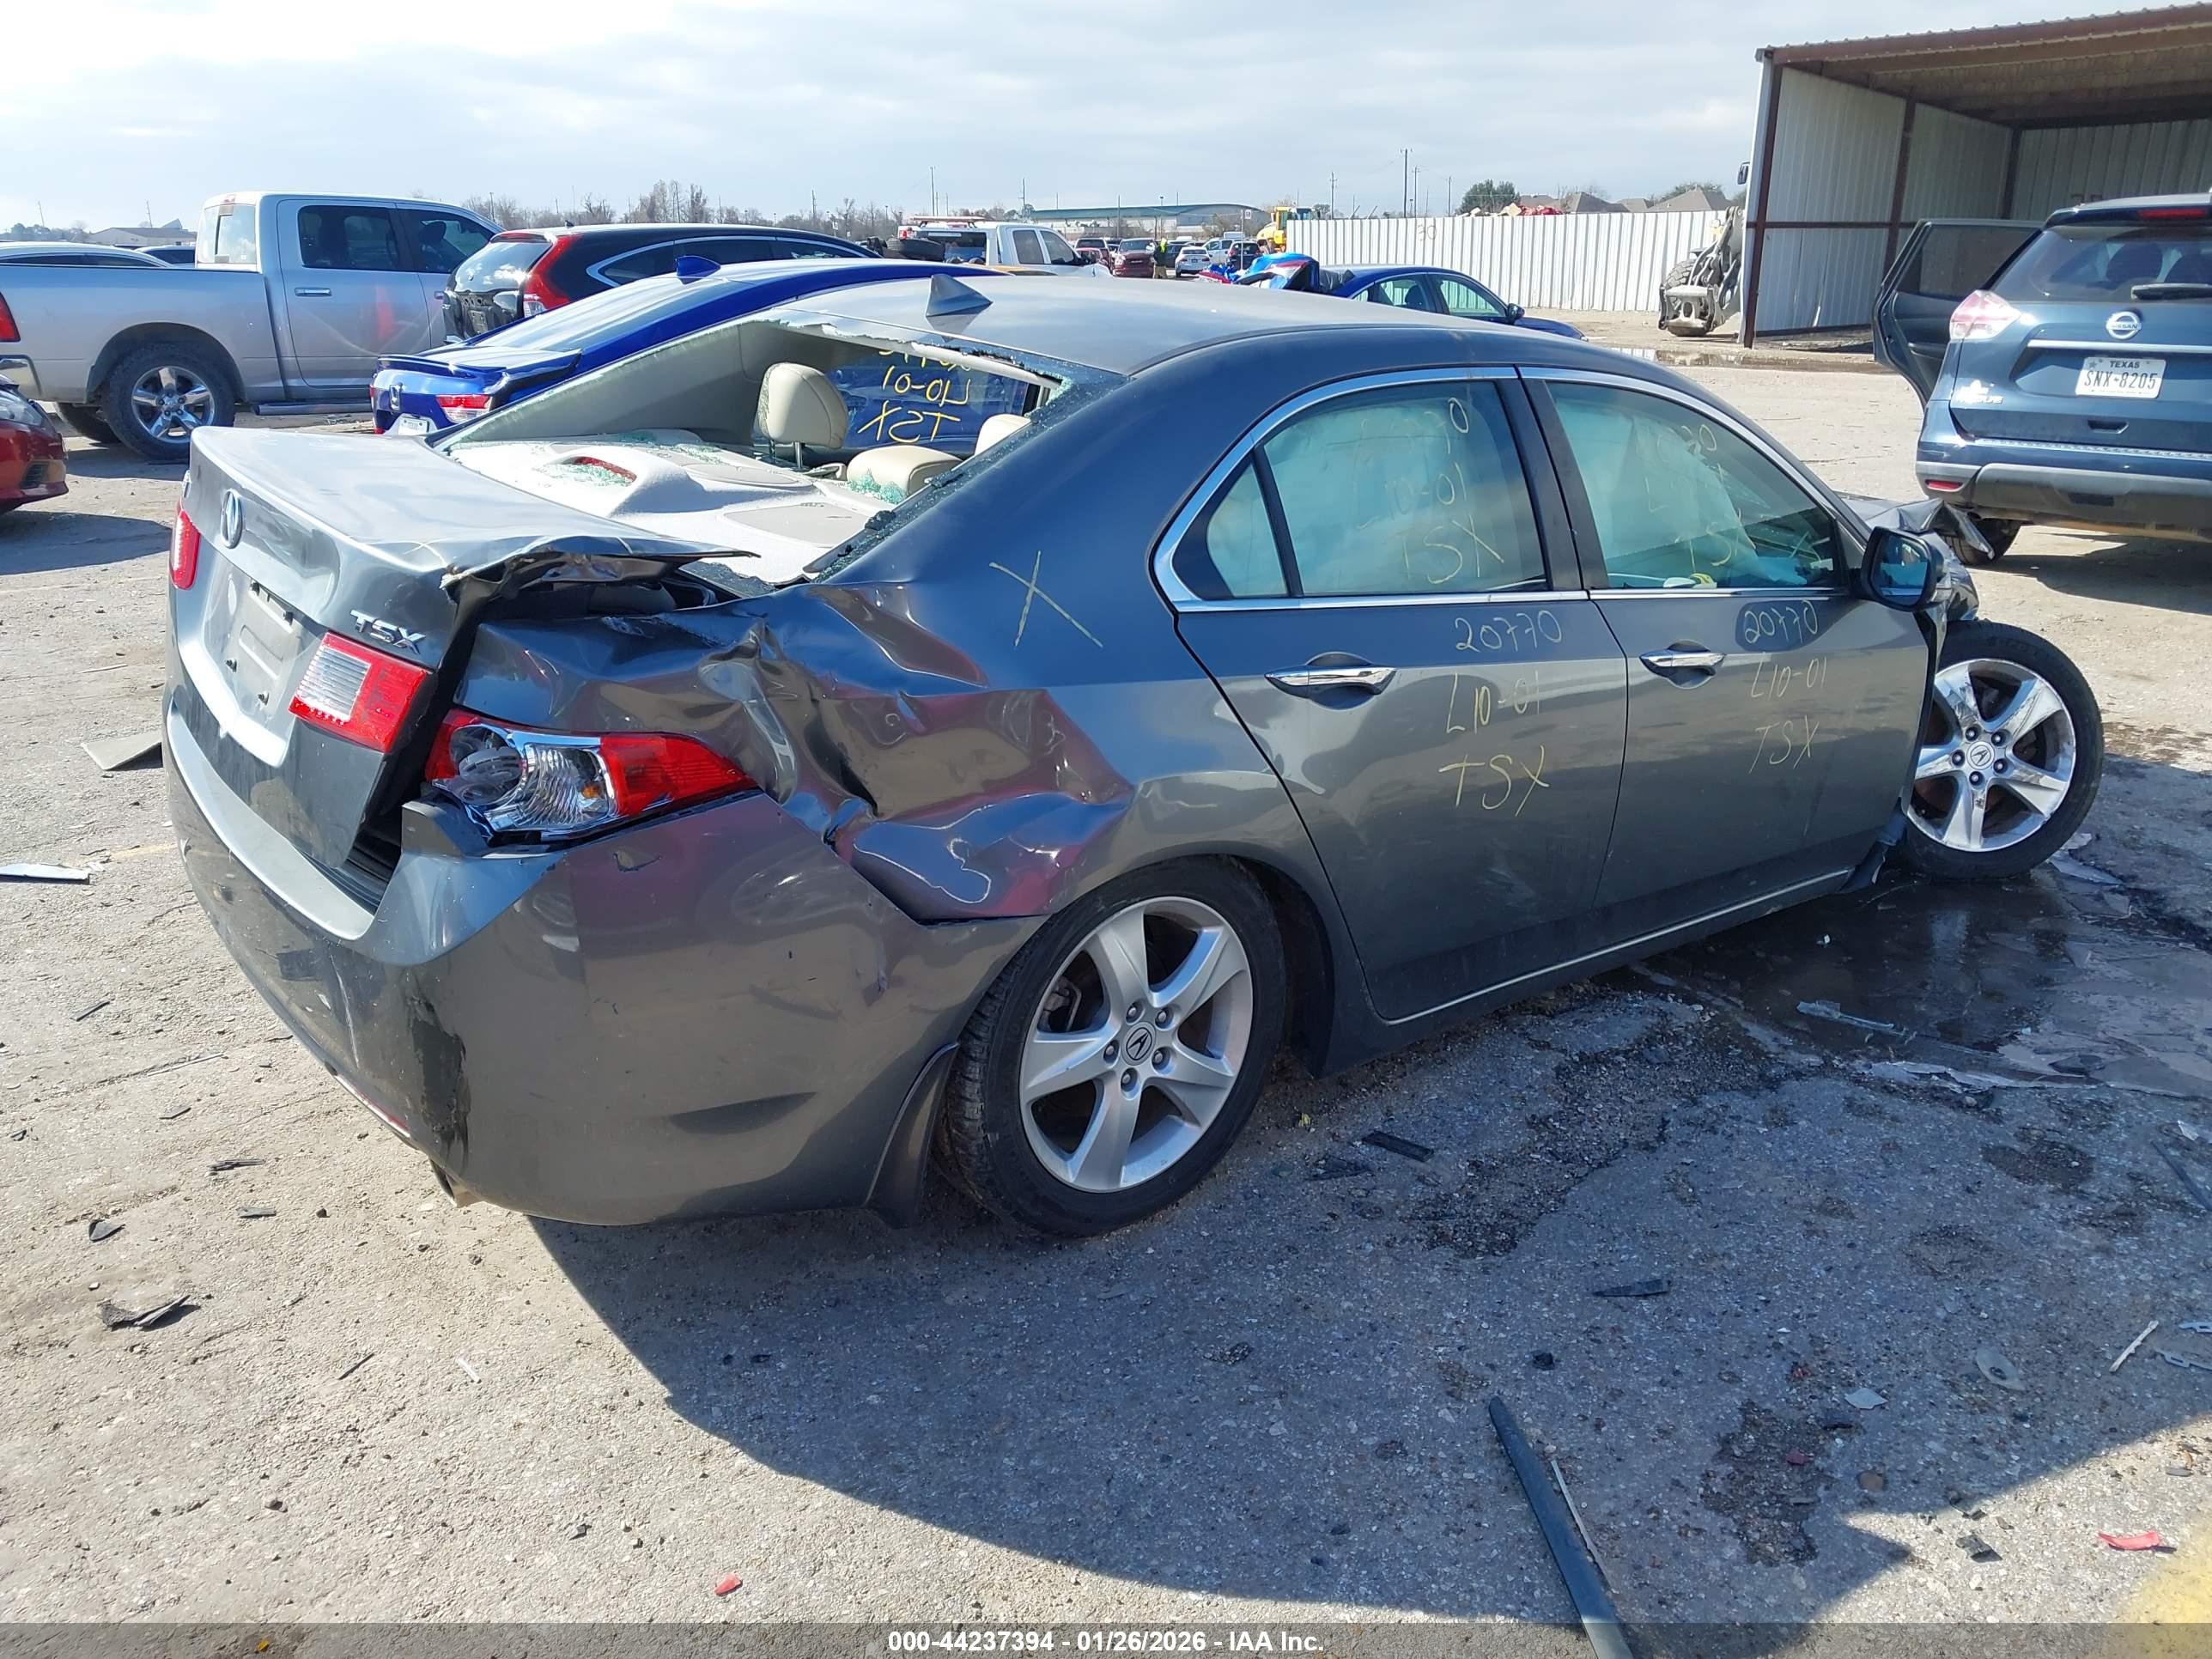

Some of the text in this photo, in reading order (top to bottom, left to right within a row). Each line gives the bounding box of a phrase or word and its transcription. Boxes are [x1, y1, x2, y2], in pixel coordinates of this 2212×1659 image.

[2109, 361, 2140, 369] TEXAS
[349, 609, 426, 655] TSX
[1455, 610, 1562, 653] 20770
[1744, 599, 1818, 644] 20770
[1751, 651, 1827, 701] L10-01
[1446, 670, 1540, 734] L10-01
[1748, 714, 1820, 774] TSX
[1437, 744, 1549, 817] TSX
